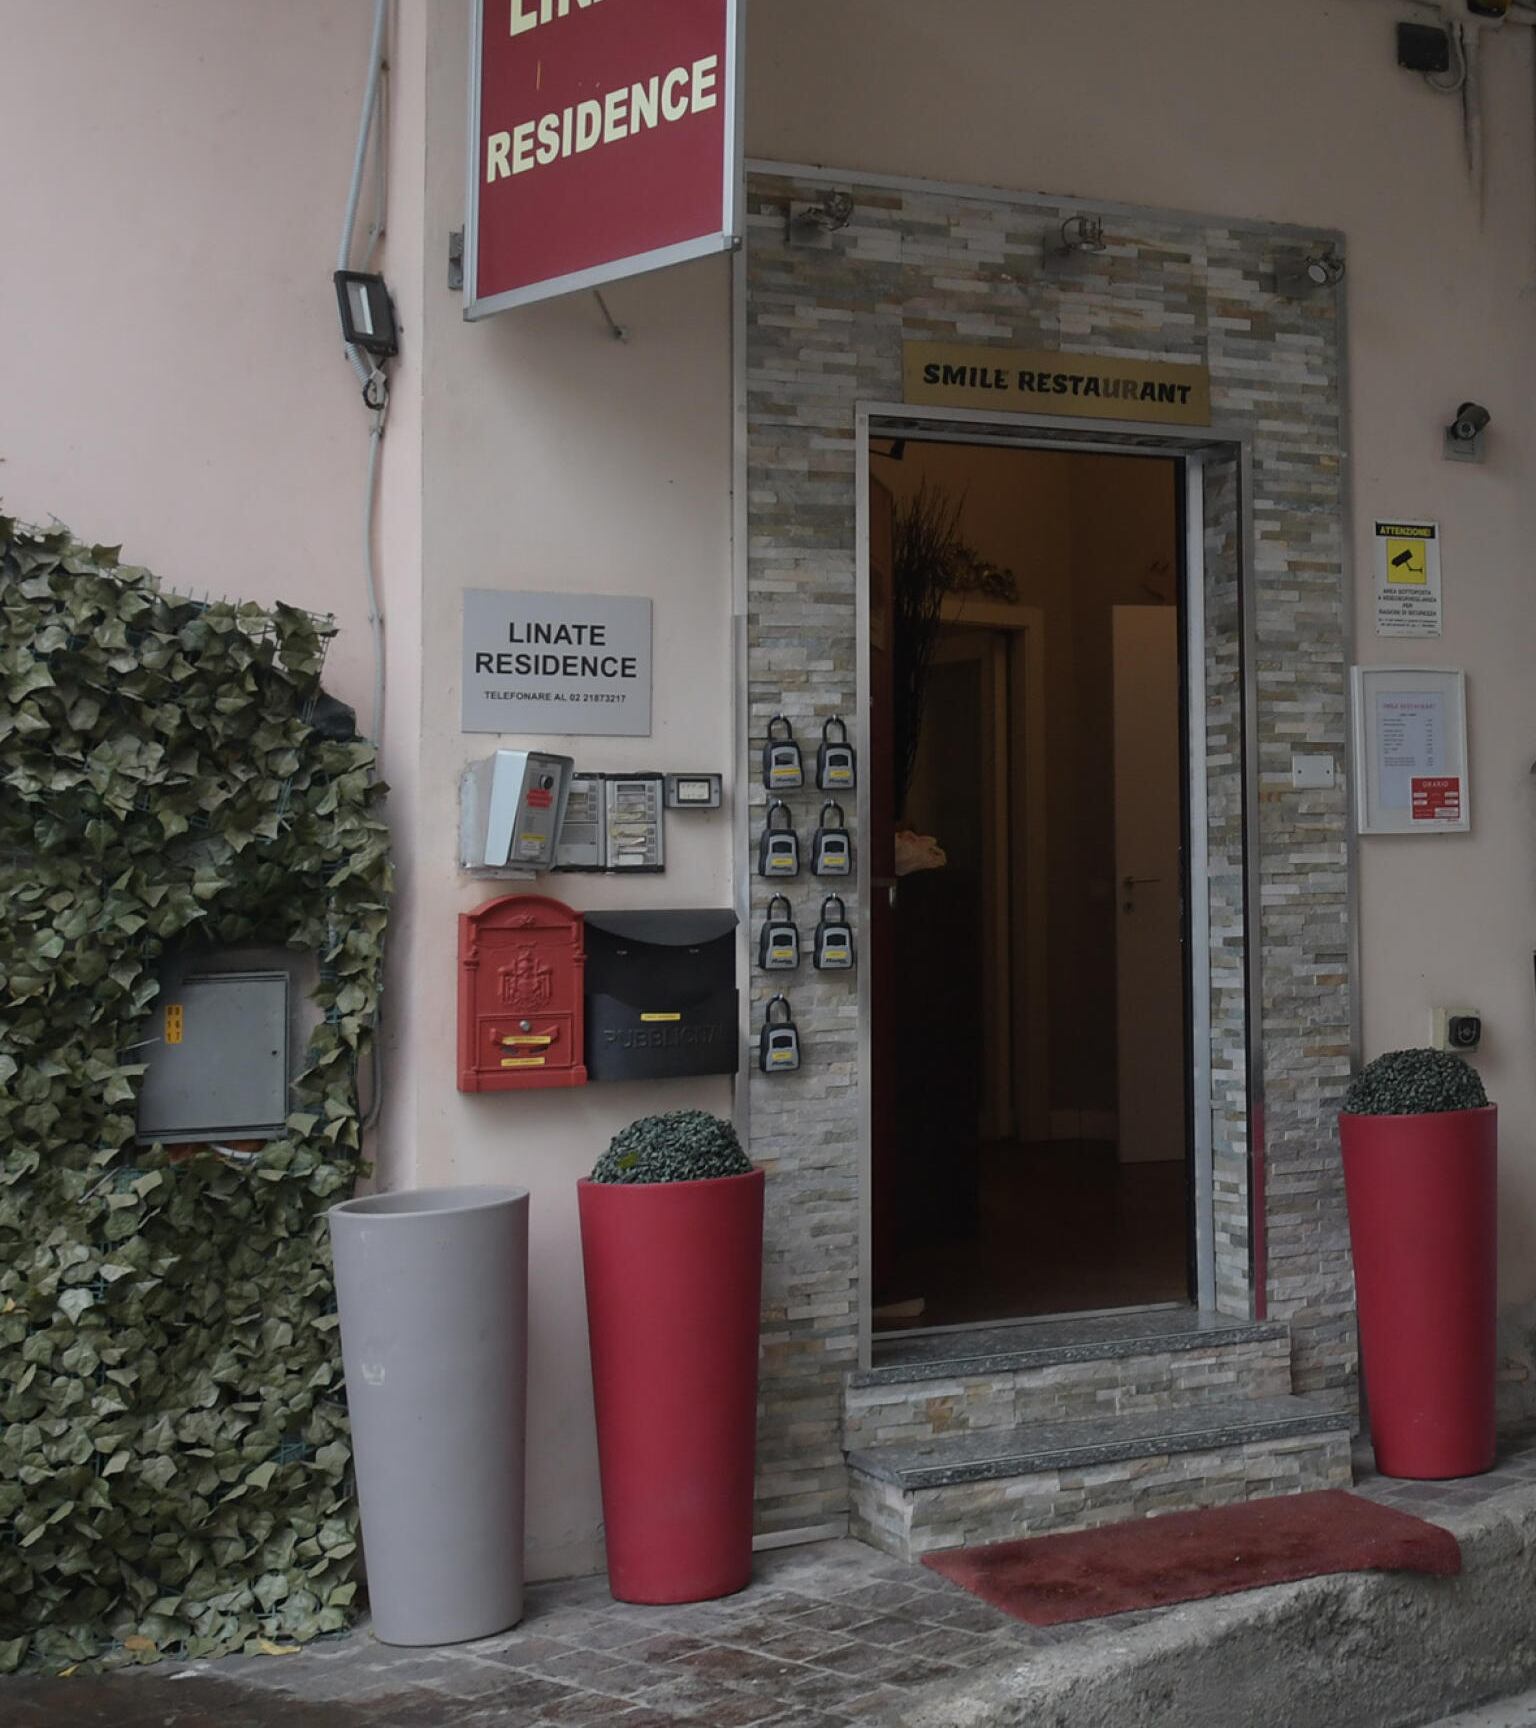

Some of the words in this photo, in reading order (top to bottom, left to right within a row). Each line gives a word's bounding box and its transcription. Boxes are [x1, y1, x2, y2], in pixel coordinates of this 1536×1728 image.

[486, 54, 718, 184] RESIDENCE
[922, 363, 1009, 391] SMILE
[1017, 369, 1192, 405] RESTAURANT
[508, 621, 606, 647] LINATE
[474, 651, 638, 678] RESIDENCE
[484, 690, 552, 701] TELEFONARE
[553, 692, 567, 701] AL
[569, 693, 581, 702] 02
